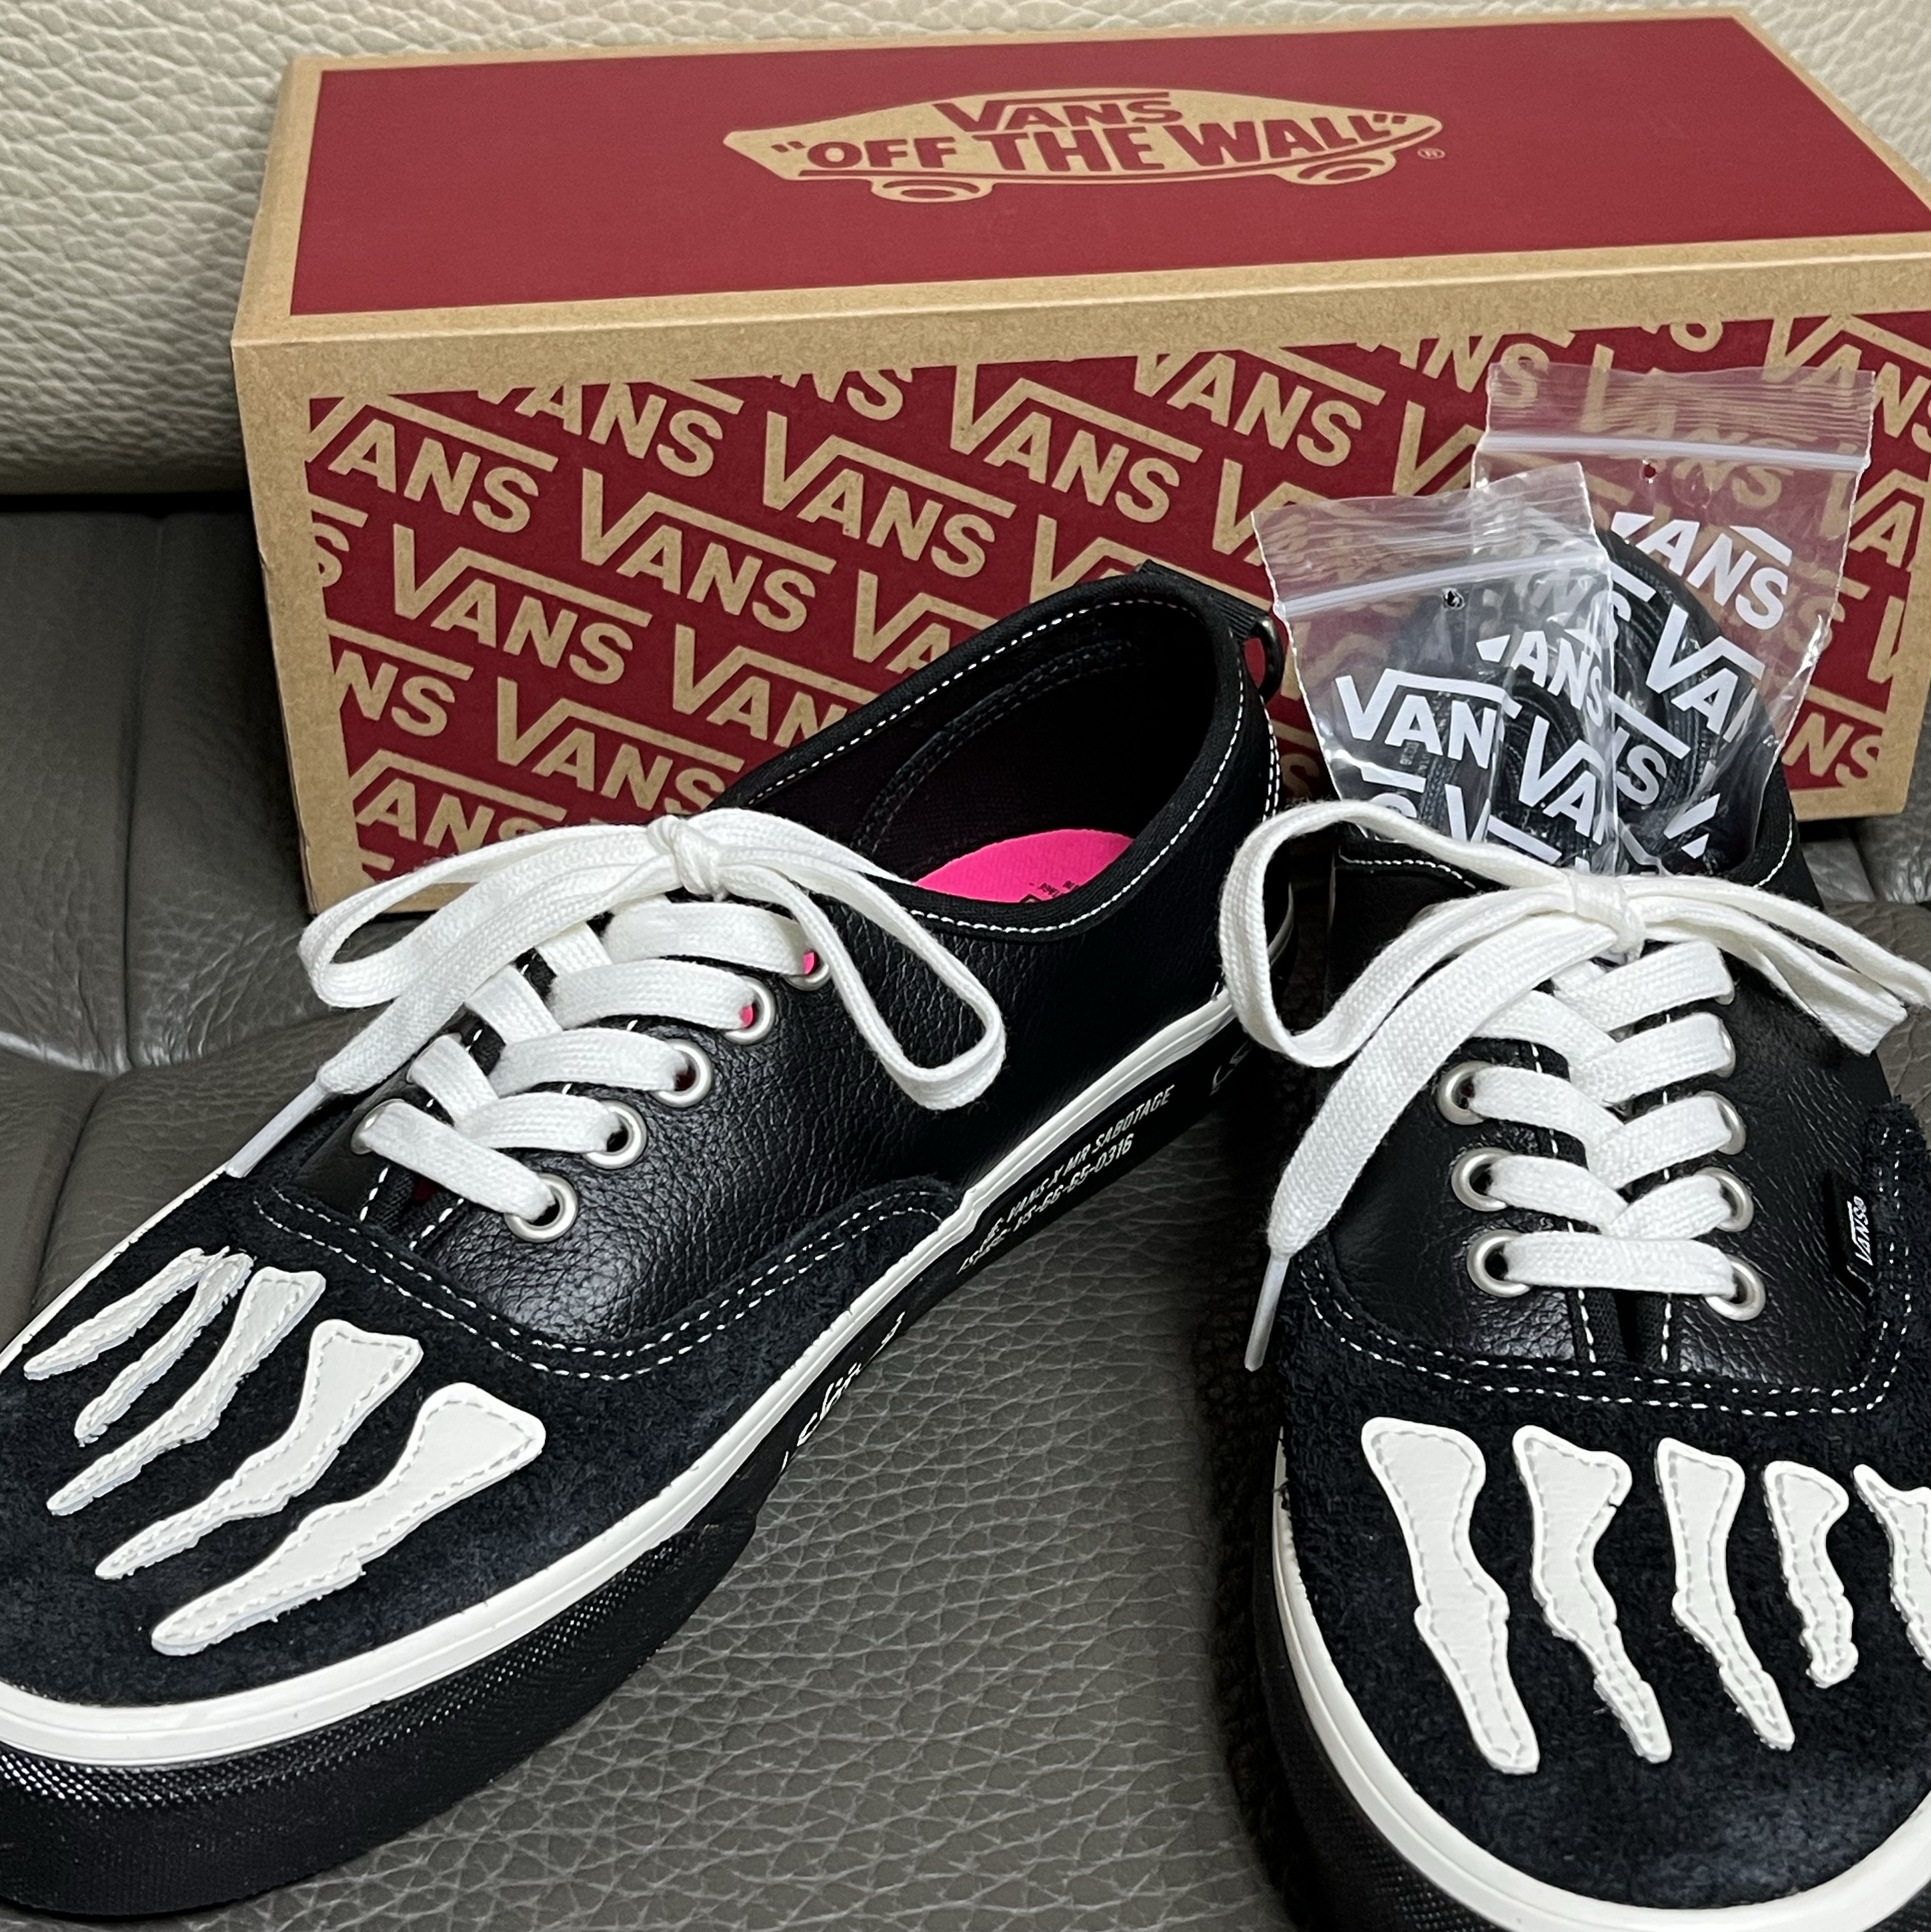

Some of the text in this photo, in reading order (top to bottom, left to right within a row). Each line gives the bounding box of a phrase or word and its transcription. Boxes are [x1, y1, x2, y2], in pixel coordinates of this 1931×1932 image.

[771, 113, 1407, 172] "OFF THE WALL"
[932, 91, 1182, 132] VANS
[478, 381, 744, 477] ANS
[950, 365, 1203, 522] VANS
[581, 467, 837, 633] VANS
[763, 411, 1017, 577] VANS
[393, 524, 653, 685] VANS
[853, 569, 1000, 674] VA
[324, 617, 474, 737] NS
[673, 623, 880, 749] VAN
[1336, 668, 1522, 770] VAN
[1645, 603, 1765, 743] VA
[1518, 714, 1605, 846] VA
[1782, 685, 1886, 787] NS
[1091, 1084, 1175, 1154] SABOTAGE
